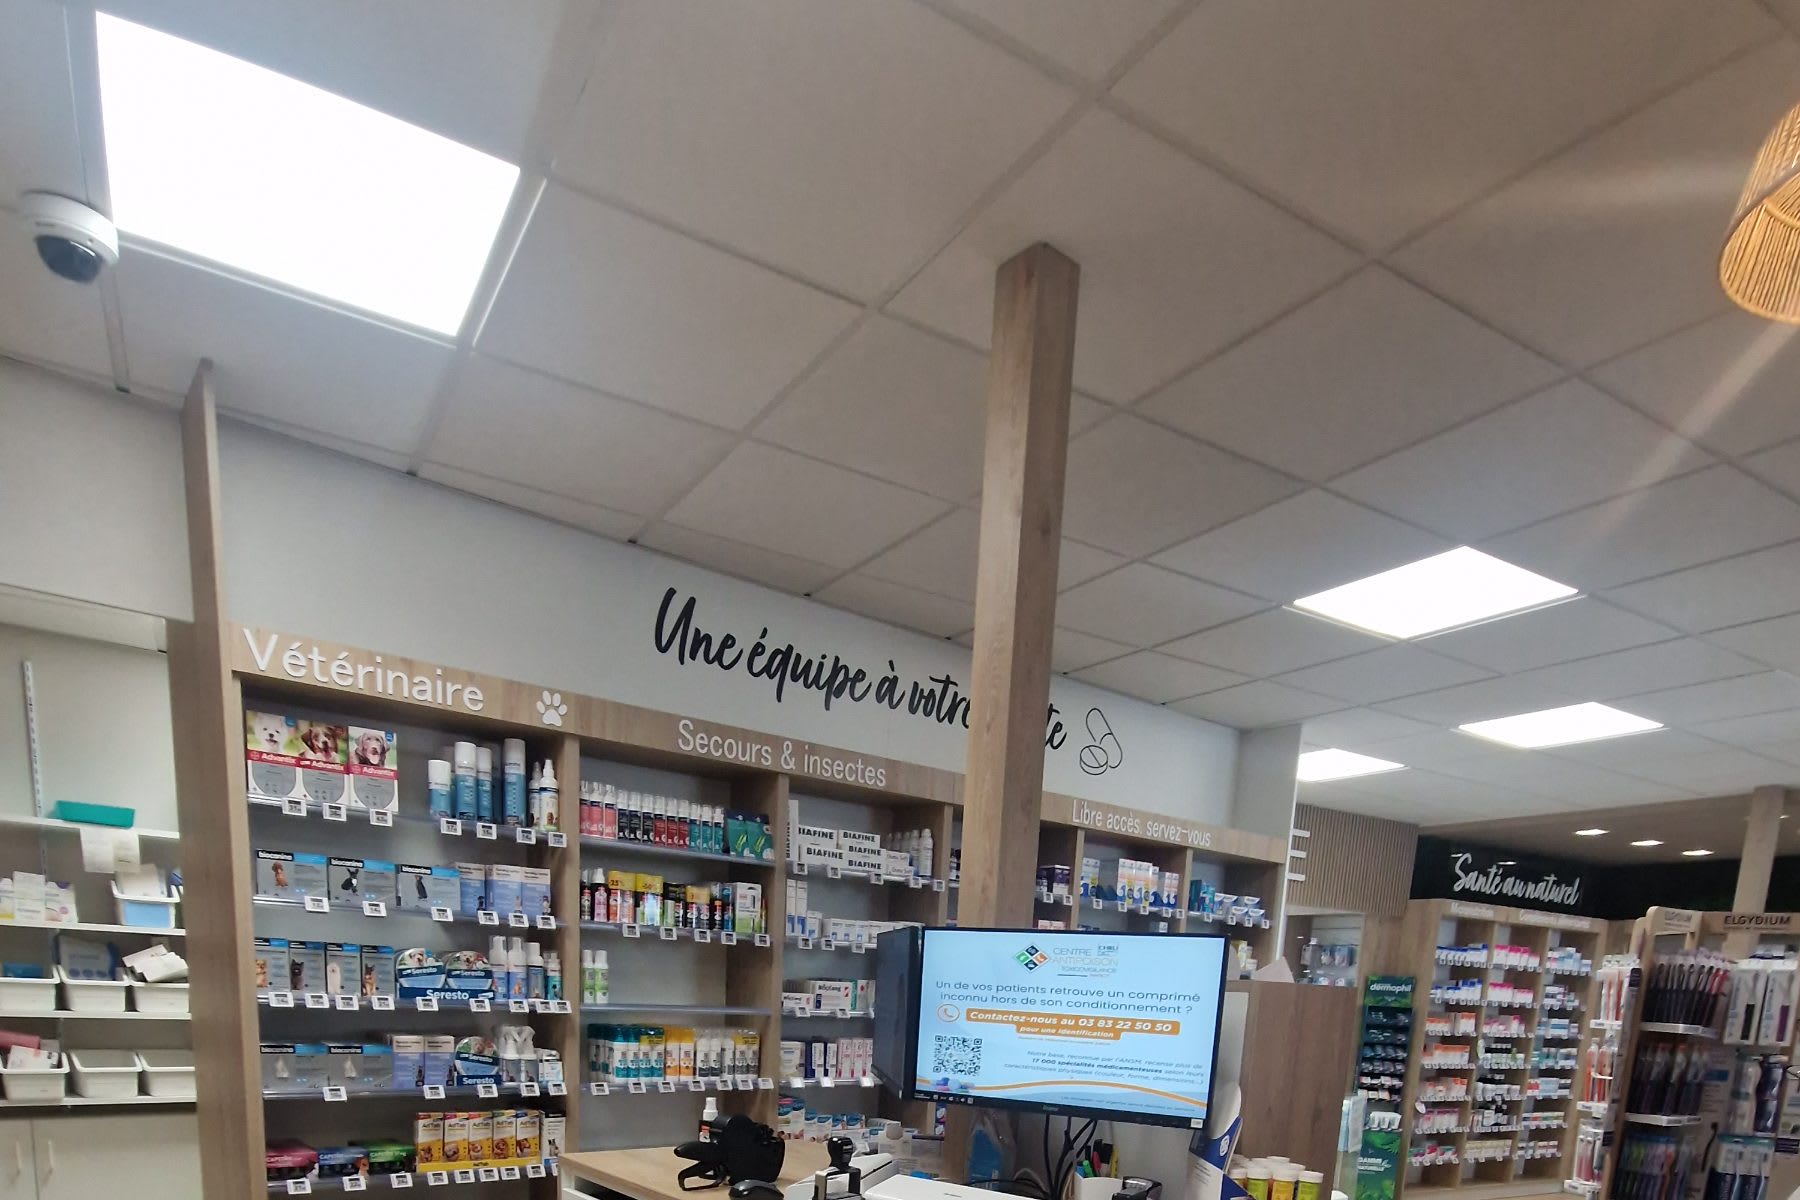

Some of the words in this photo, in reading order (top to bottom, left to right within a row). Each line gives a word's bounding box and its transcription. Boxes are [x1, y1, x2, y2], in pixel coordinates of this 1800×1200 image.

[655, 587, 742, 671] Une
[746, 627, 872, 712] équipe
[876, 660, 906, 710] à
[243, 628, 485, 712] Vétérinaire
[678, 719, 772, 766] Secours
[780, 742, 796, 770] &
[804, 745, 886, 787] insectes
[1072, 799, 1103, 827] Libre
[1146, 820, 1212, 848] servez-vous
[843, 831, 876, 843] BIAFINE
[806, 847, 844, 860] BIAFINE
[848, 845, 882, 857] BIAFINE
[848, 859, 882, 870] BIAFINE
[1452, 852, 1501, 895] Santé
[1501, 875, 1526, 898] au
[1525, 874, 1582, 905] naturel
[1724, 915, 1791, 930] ELGYDIUM
[1053, 947, 1092, 956] CENTRE
[411, 967, 437, 975] Seresto
[936, 981, 951, 990] Un
[954, 982, 970, 991] de
[996, 983, 1047, 994] patients
[1050, 987, 1104, 998] retrouve
[1107, 990, 1124, 999] un
[1128, 990, 1201, 1004] comprimé
[1369, 983, 1412, 994] dermophil
[426, 989, 470, 1001] Seresto
[940, 991, 989, 1003] inconnu
[991, 993, 1018, 1005] hors
[1020, 995, 1037, 1006] de
[1040, 999, 1064, 1008] son
[1066, 998, 1182, 1014] conditionnement
[1185, 1005, 1193, 1014] ?
[970, 1011, 1058, 1026] Contactez-nous
[1078, 1018, 1094, 1027] 03
[1097, 1019, 1113, 1028] 83
[1115, 1021, 1132, 1029] 22
[1134, 1022, 1152, 1031] 50
[1154, 1023, 1172, 1032] 50
[1058, 1028, 1114, 1039] identification
[468, 1053, 493, 1063] Seresto
[462, 1077, 494, 1085] Seresto
